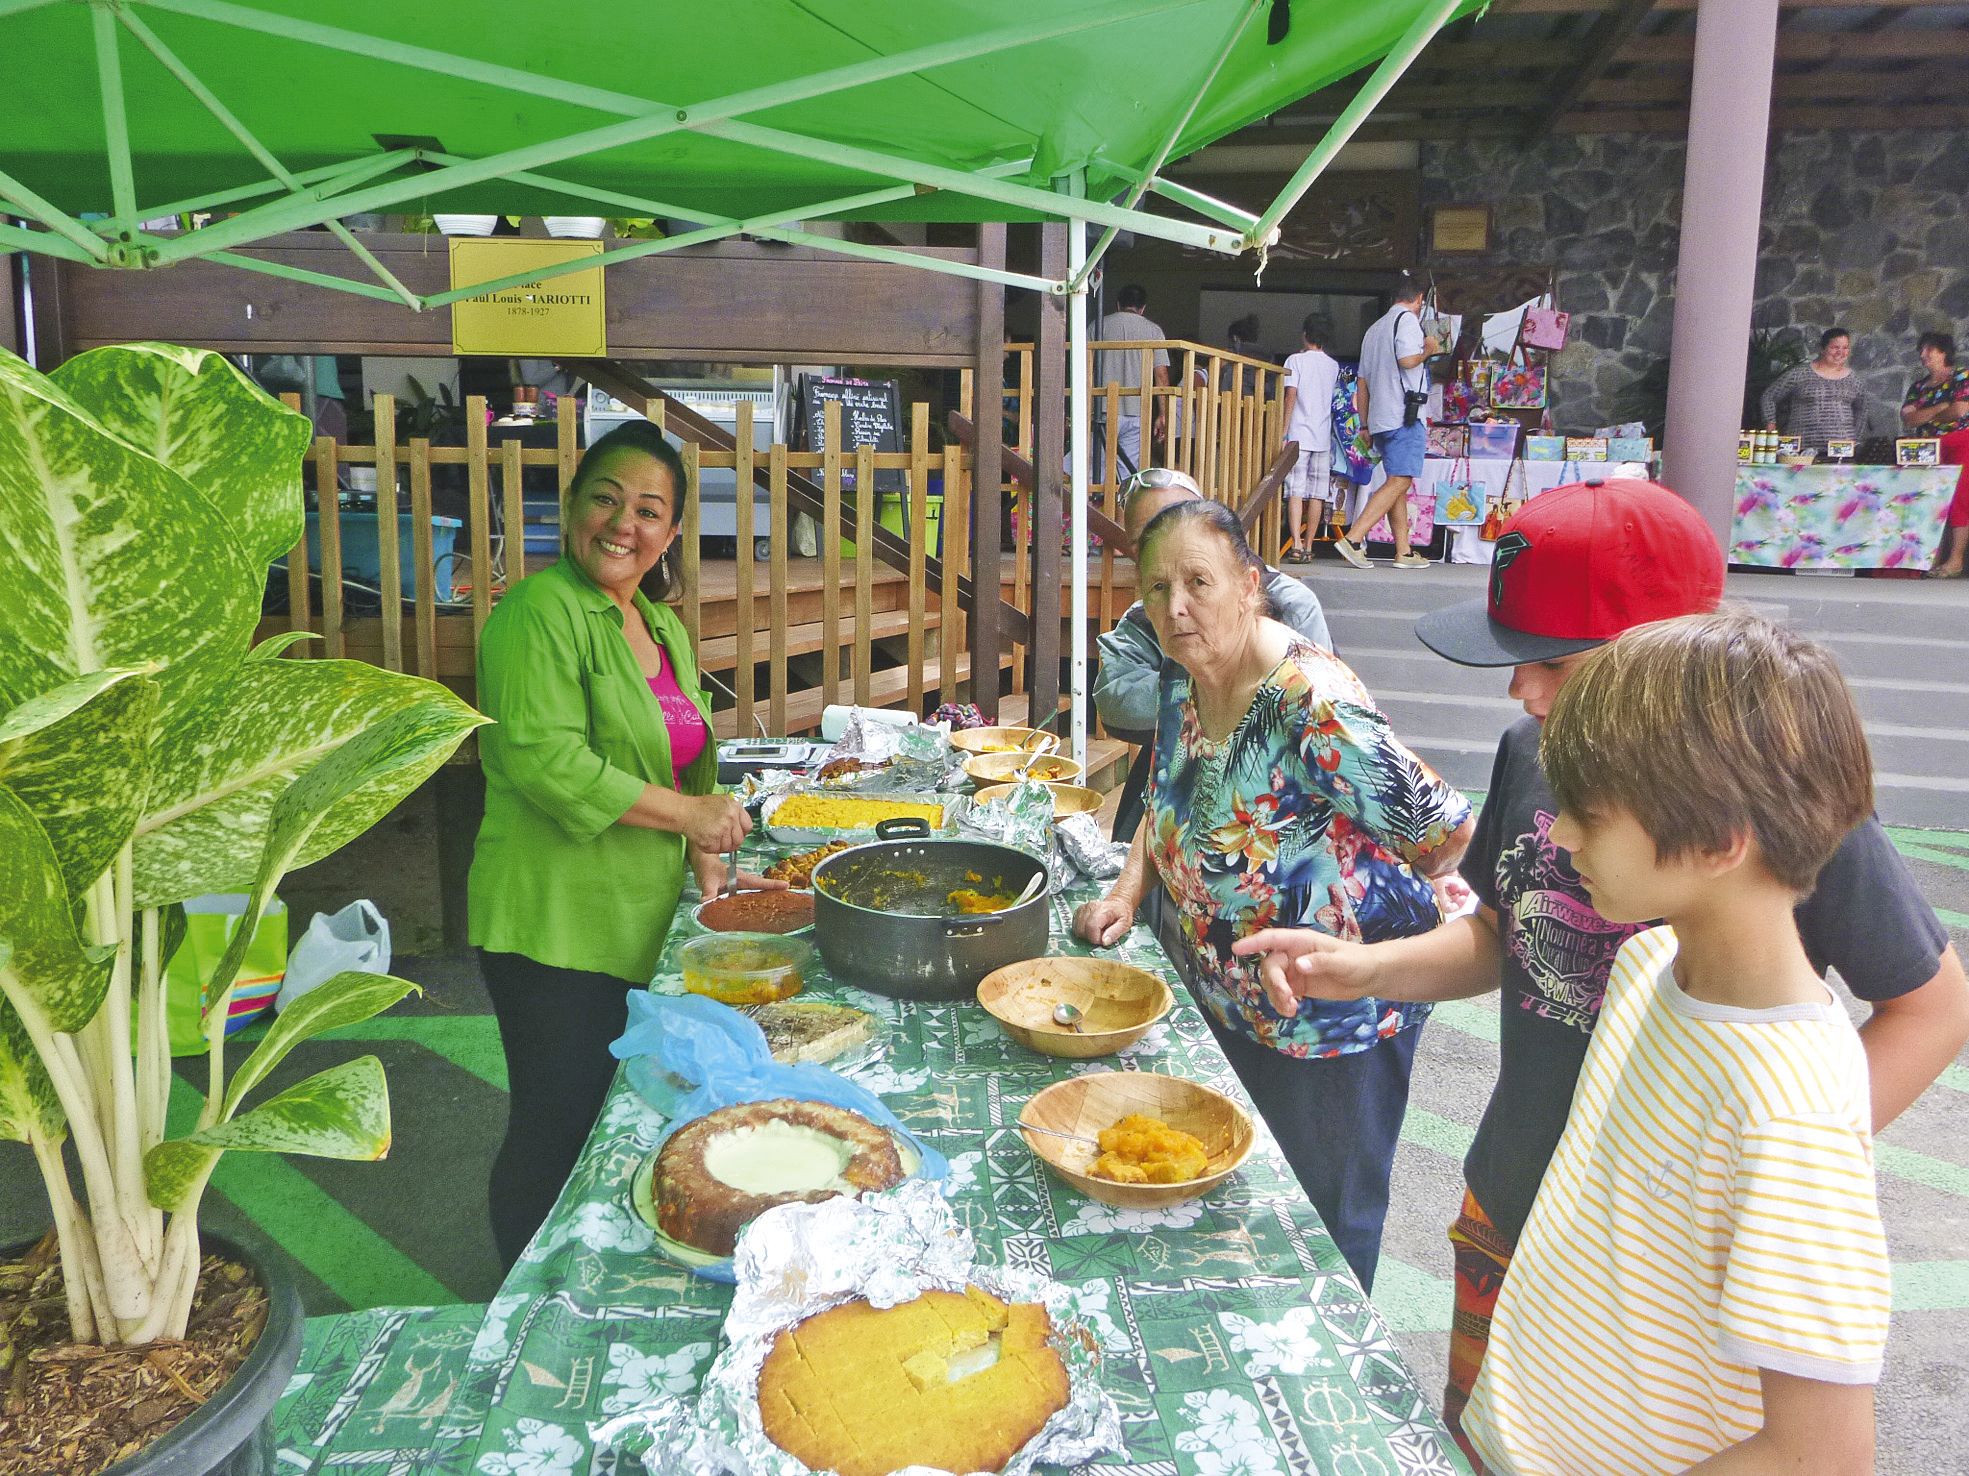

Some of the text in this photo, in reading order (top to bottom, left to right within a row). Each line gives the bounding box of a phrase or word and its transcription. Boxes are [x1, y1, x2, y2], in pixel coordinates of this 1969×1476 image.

[514, 281, 542, 289] ace
[493, 293, 522, 303] Louis
[507, 307, 550, 316] 1878-1927
[1522, 891, 1615, 931] Airwaves
